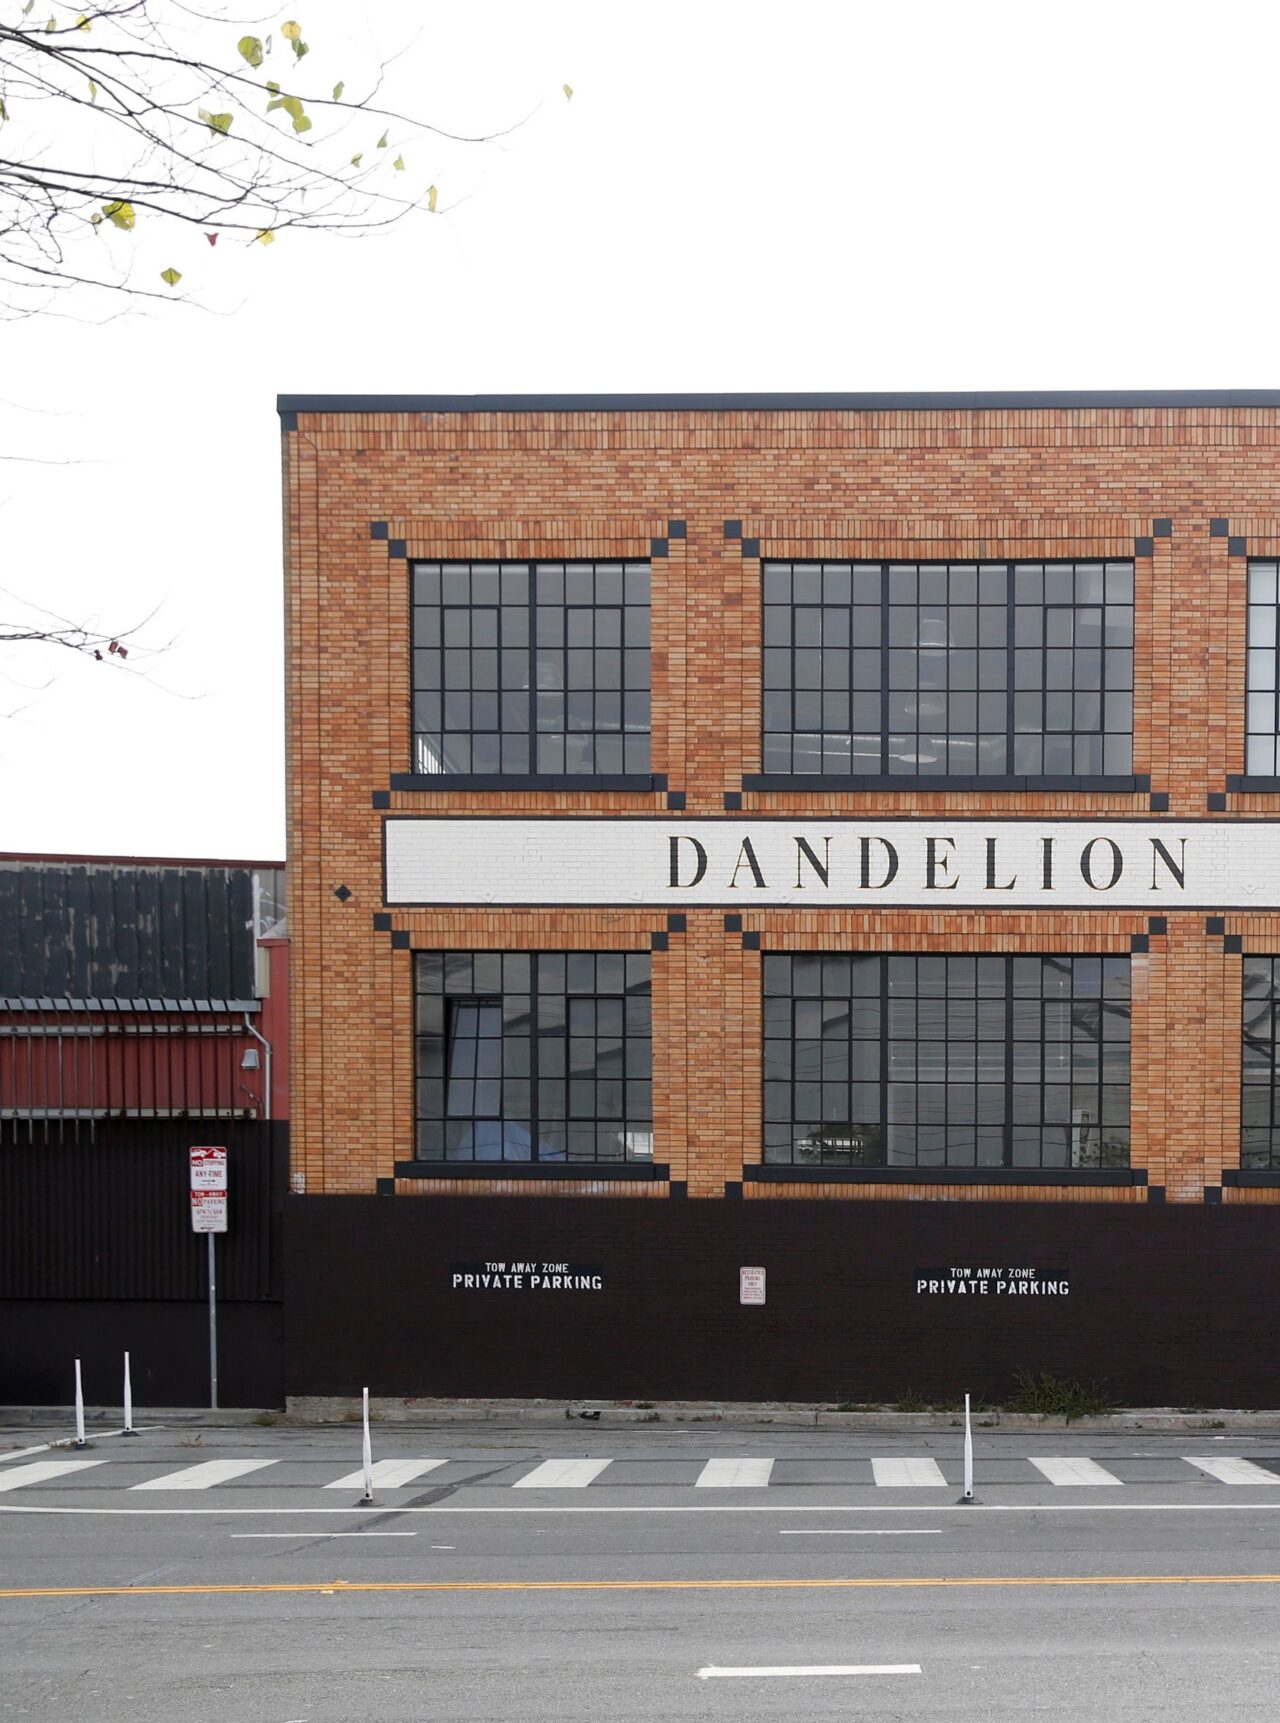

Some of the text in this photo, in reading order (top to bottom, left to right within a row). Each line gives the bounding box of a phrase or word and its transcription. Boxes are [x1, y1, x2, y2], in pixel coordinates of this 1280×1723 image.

[668, 836, 1188, 890] DANDELION
[485, 1262, 569, 1273] TOW AWAY ZONE
[950, 1268, 1036, 1279] TOW AWAY ZONE
[452, 1274, 602, 1290] PRIVATE PARKING
[917, 1280, 1069, 1295] PRIVATE PARKING
